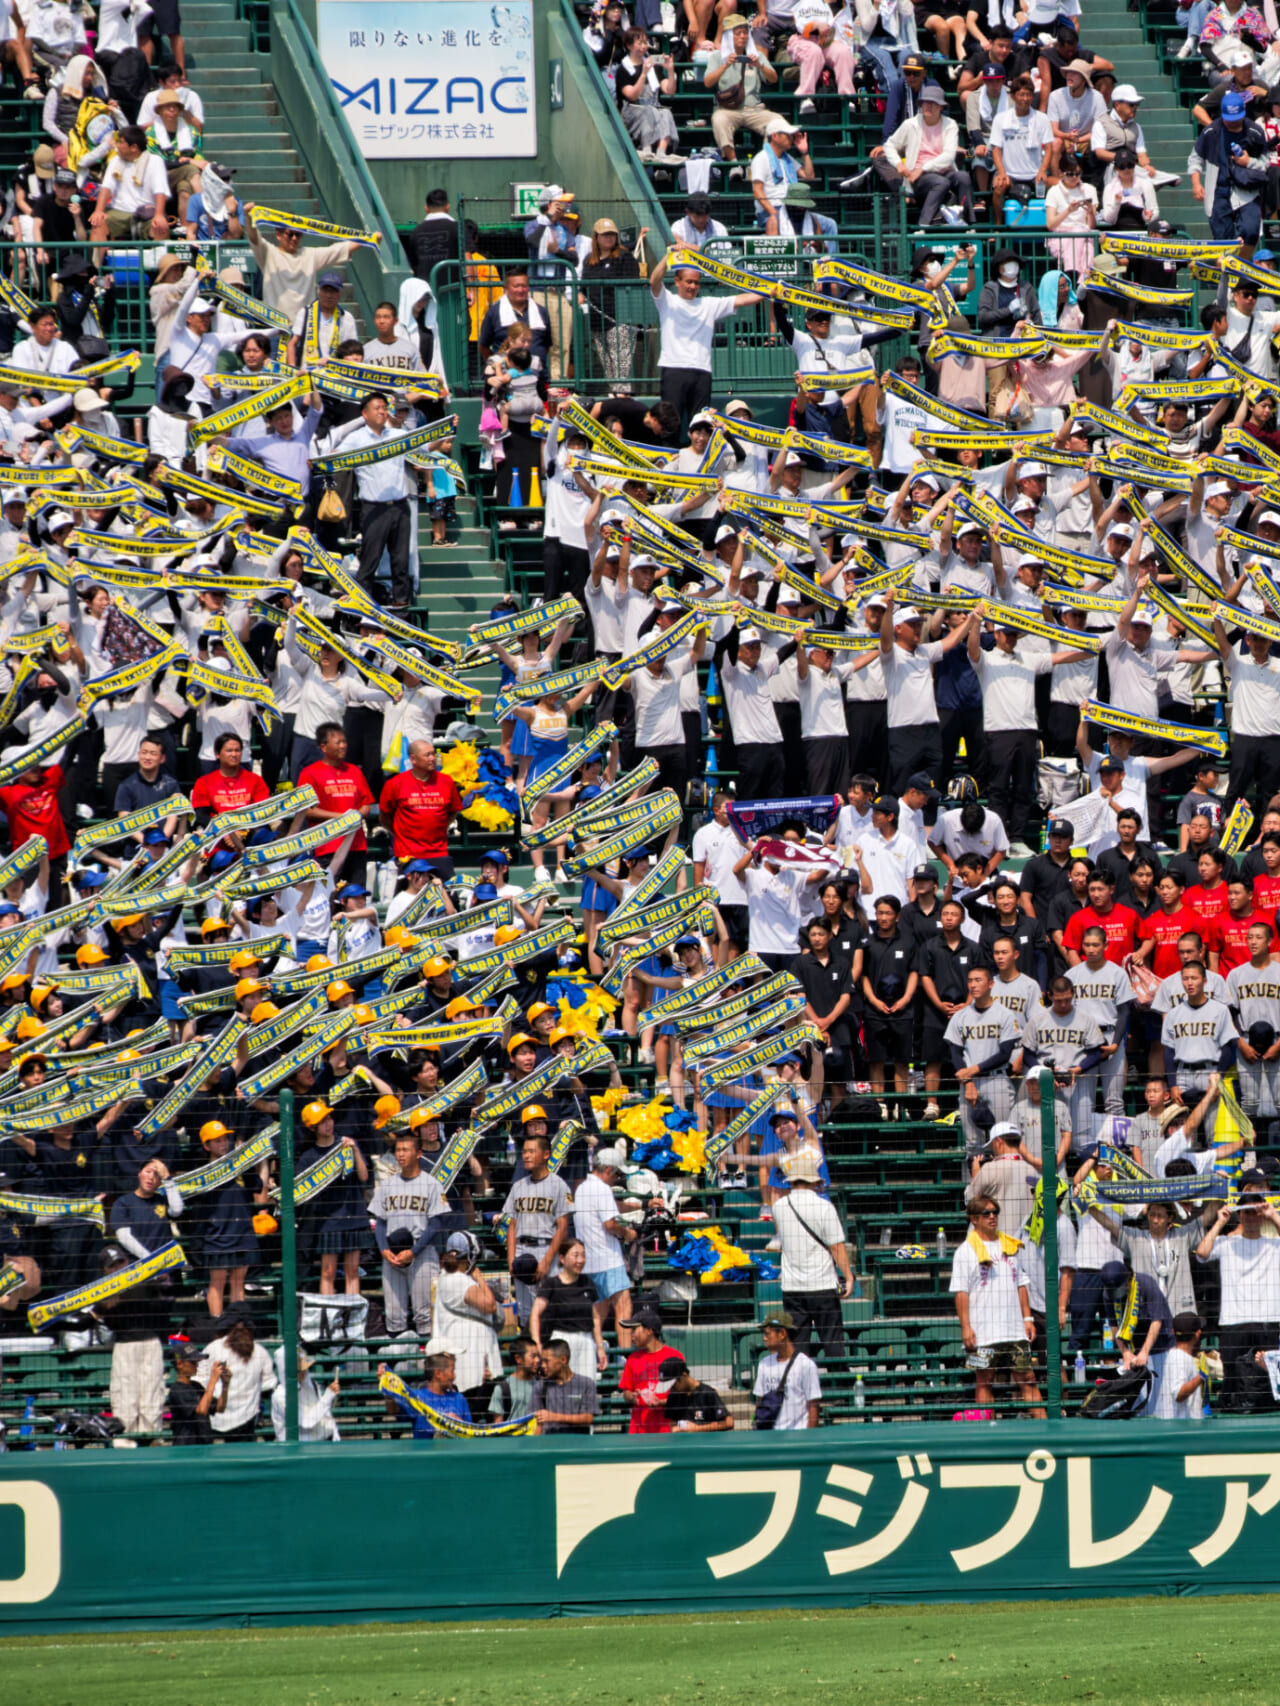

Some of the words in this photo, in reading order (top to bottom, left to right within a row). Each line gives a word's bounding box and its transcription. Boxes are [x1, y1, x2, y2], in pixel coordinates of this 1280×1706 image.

[349, 29, 503, 48] 限りない進化を
[330, 76, 527, 114] MIZAC
[362, 124, 494, 139] ミザック株式会社
[832, 265, 868, 285] SENDAI
[868, 278, 898, 295] IKUEI
[979, 343, 1006, 356] IKUEI
[933, 435, 970, 447] SENDAI
[972, 435, 1000, 447] IKUEI
[332, 449, 376, 470] SENDAI
[376, 441, 406, 461] IKUEI
[470, 621, 511, 643] SENDAI
[511, 611, 545, 631] IKUEI
[1100, 712, 1137, 729] SENDAI
[1139, 719, 1168, 736] IKUEI
[1073, 983, 1116, 999] IKUEI
[961, 1023, 1001, 1040] IKUEI
[1037, 1028, 1086, 1045] IKUEI
[1174, 1022, 1216, 1038] IKUEI
[514, 1198, 555, 1214] IKUEI
